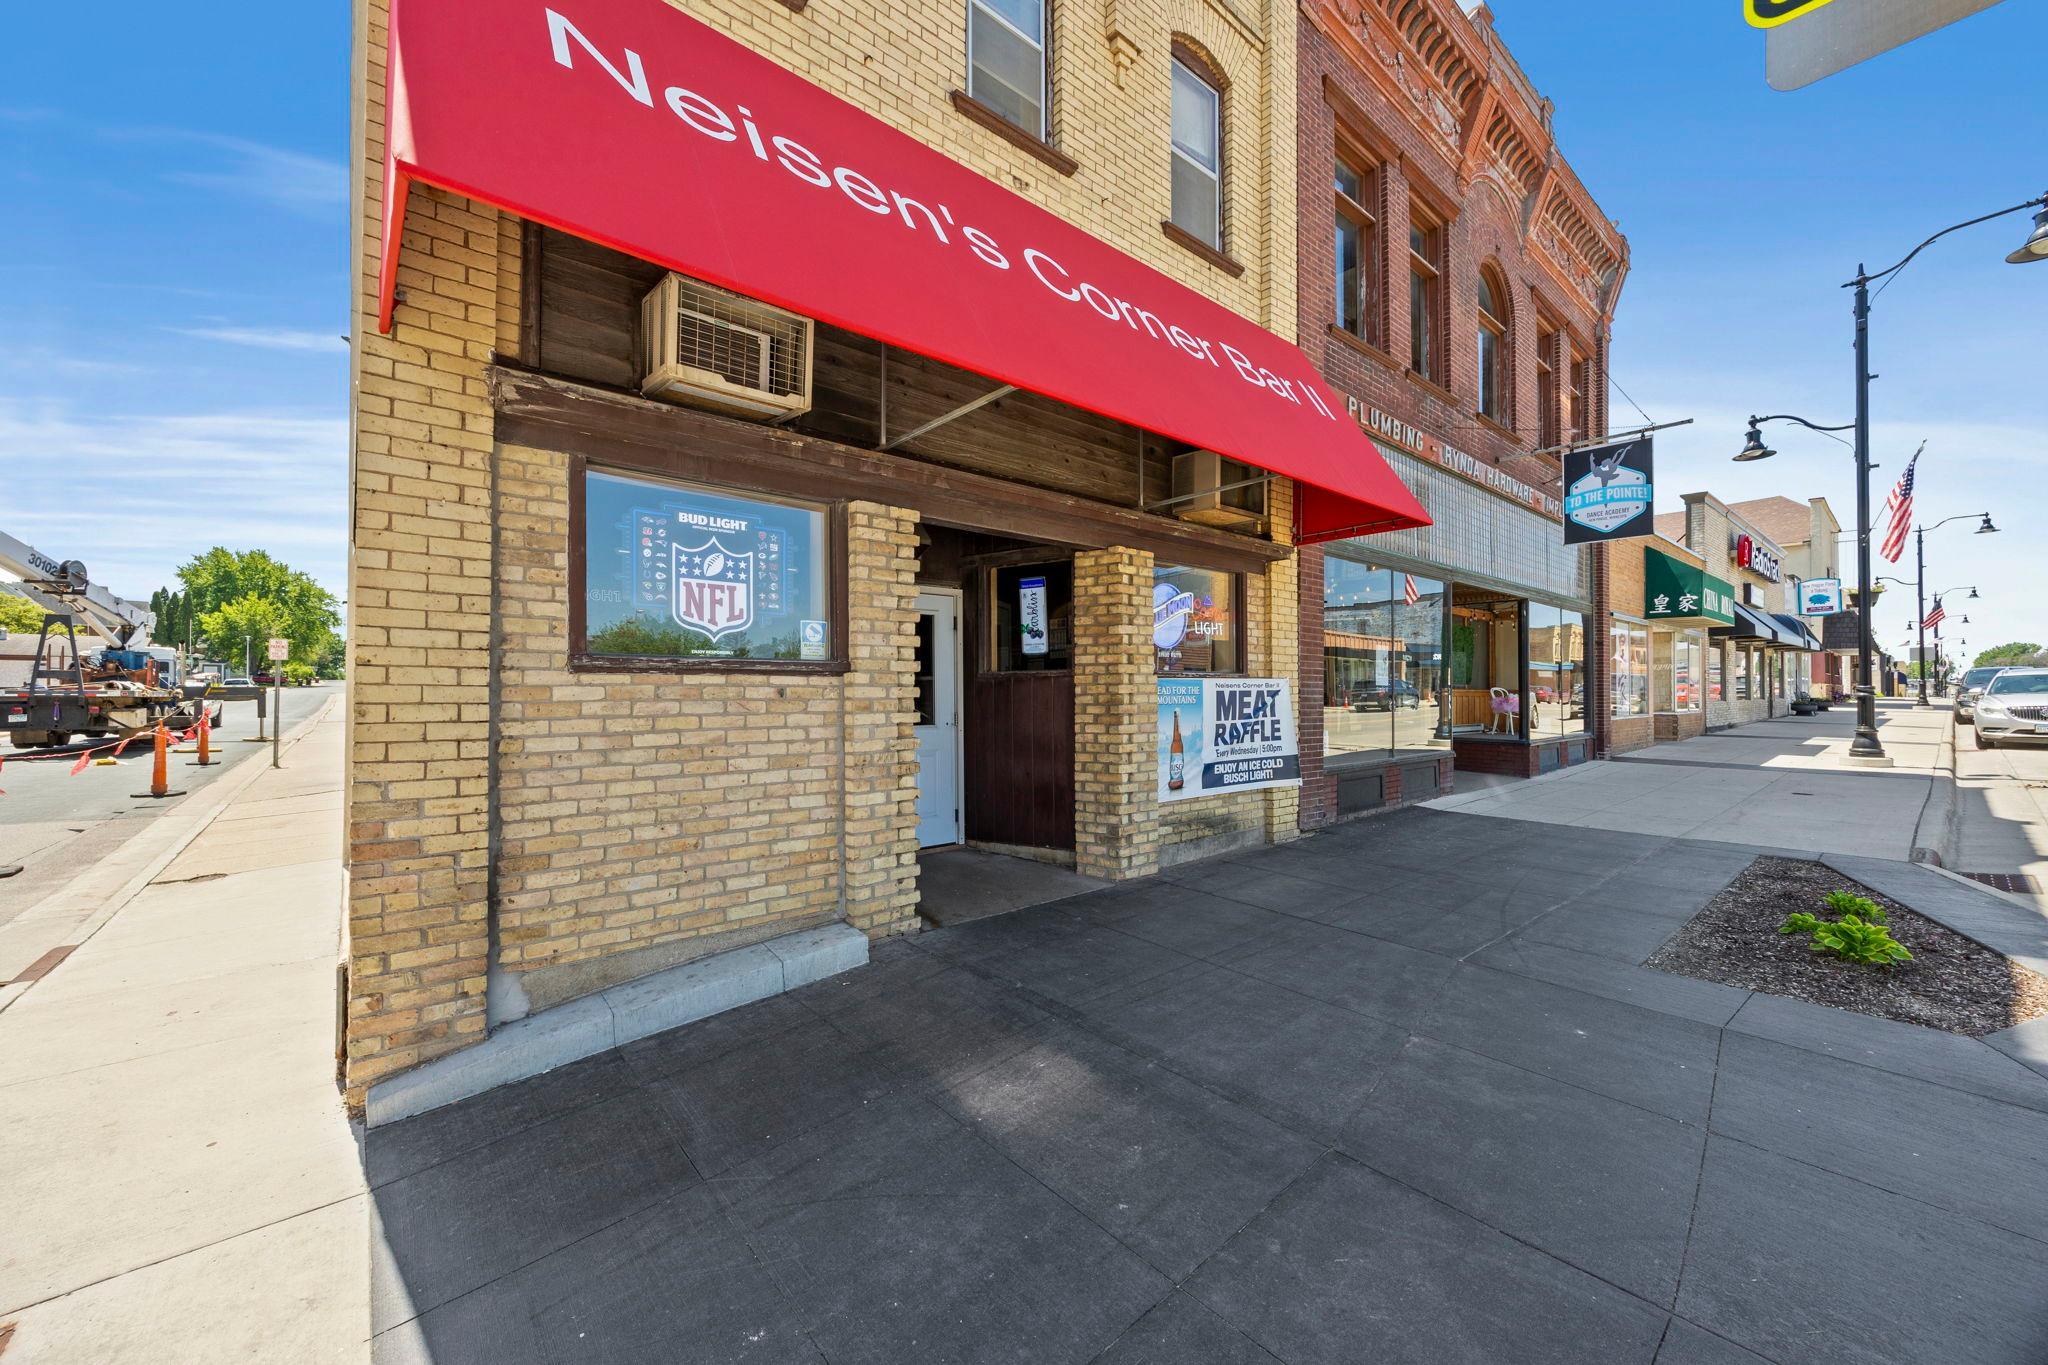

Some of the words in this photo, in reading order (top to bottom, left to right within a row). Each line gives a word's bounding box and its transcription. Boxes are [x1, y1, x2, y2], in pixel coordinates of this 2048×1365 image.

[544, 7, 1010, 270] Neisen's
[1023, 248, 1219, 368] Corner
[1218, 341, 1301, 405] Bar
[1348, 395, 1424, 452] PLUMBING
[1486, 468, 1534, 507] HARDWARE
[1545, 496, 1563, 518] IMPL
[1570, 496, 1582, 508] TO
[1584, 490, 1604, 504] THE
[1606, 487, 1648, 501] POINTE!
[678, 512, 708, 525] BUD
[709, 516, 748, 531] LIGHT
[1586, 511, 1603, 519] DANCE
[1604, 507, 1630, 516] ACADEMY
[28, 553, 58, 577] 30102
[682, 581, 744, 627] NFL
[1167, 595, 1192, 617] MOON
[1649, 593, 1699, 614] 皇家
[1194, 621, 1224, 636] LIGHT
[1157, 687, 1171, 695] EAD
[1172, 687, 1186, 695] FOR
[1187, 686, 1201, 695] THE
[1157, 695, 1197, 705] MOUNTAINS
[1215, 689, 1281, 721] MEAT
[1214, 719, 1282, 746] RAFFLE
[1215, 749, 1230, 758] Every
[1230, 746, 1259, 756] Wednesday
[1262, 744, 1283, 754] 5:00pm
[1214, 763, 1238, 774] ENJOY
[1238, 761, 1249, 772] AN
[1249, 760, 1261, 771] ICE
[1261, 758, 1284, 769] COLD
[1223, 772, 1249, 784] BUSCH
[1250, 770, 1274, 782] LIGHT!
